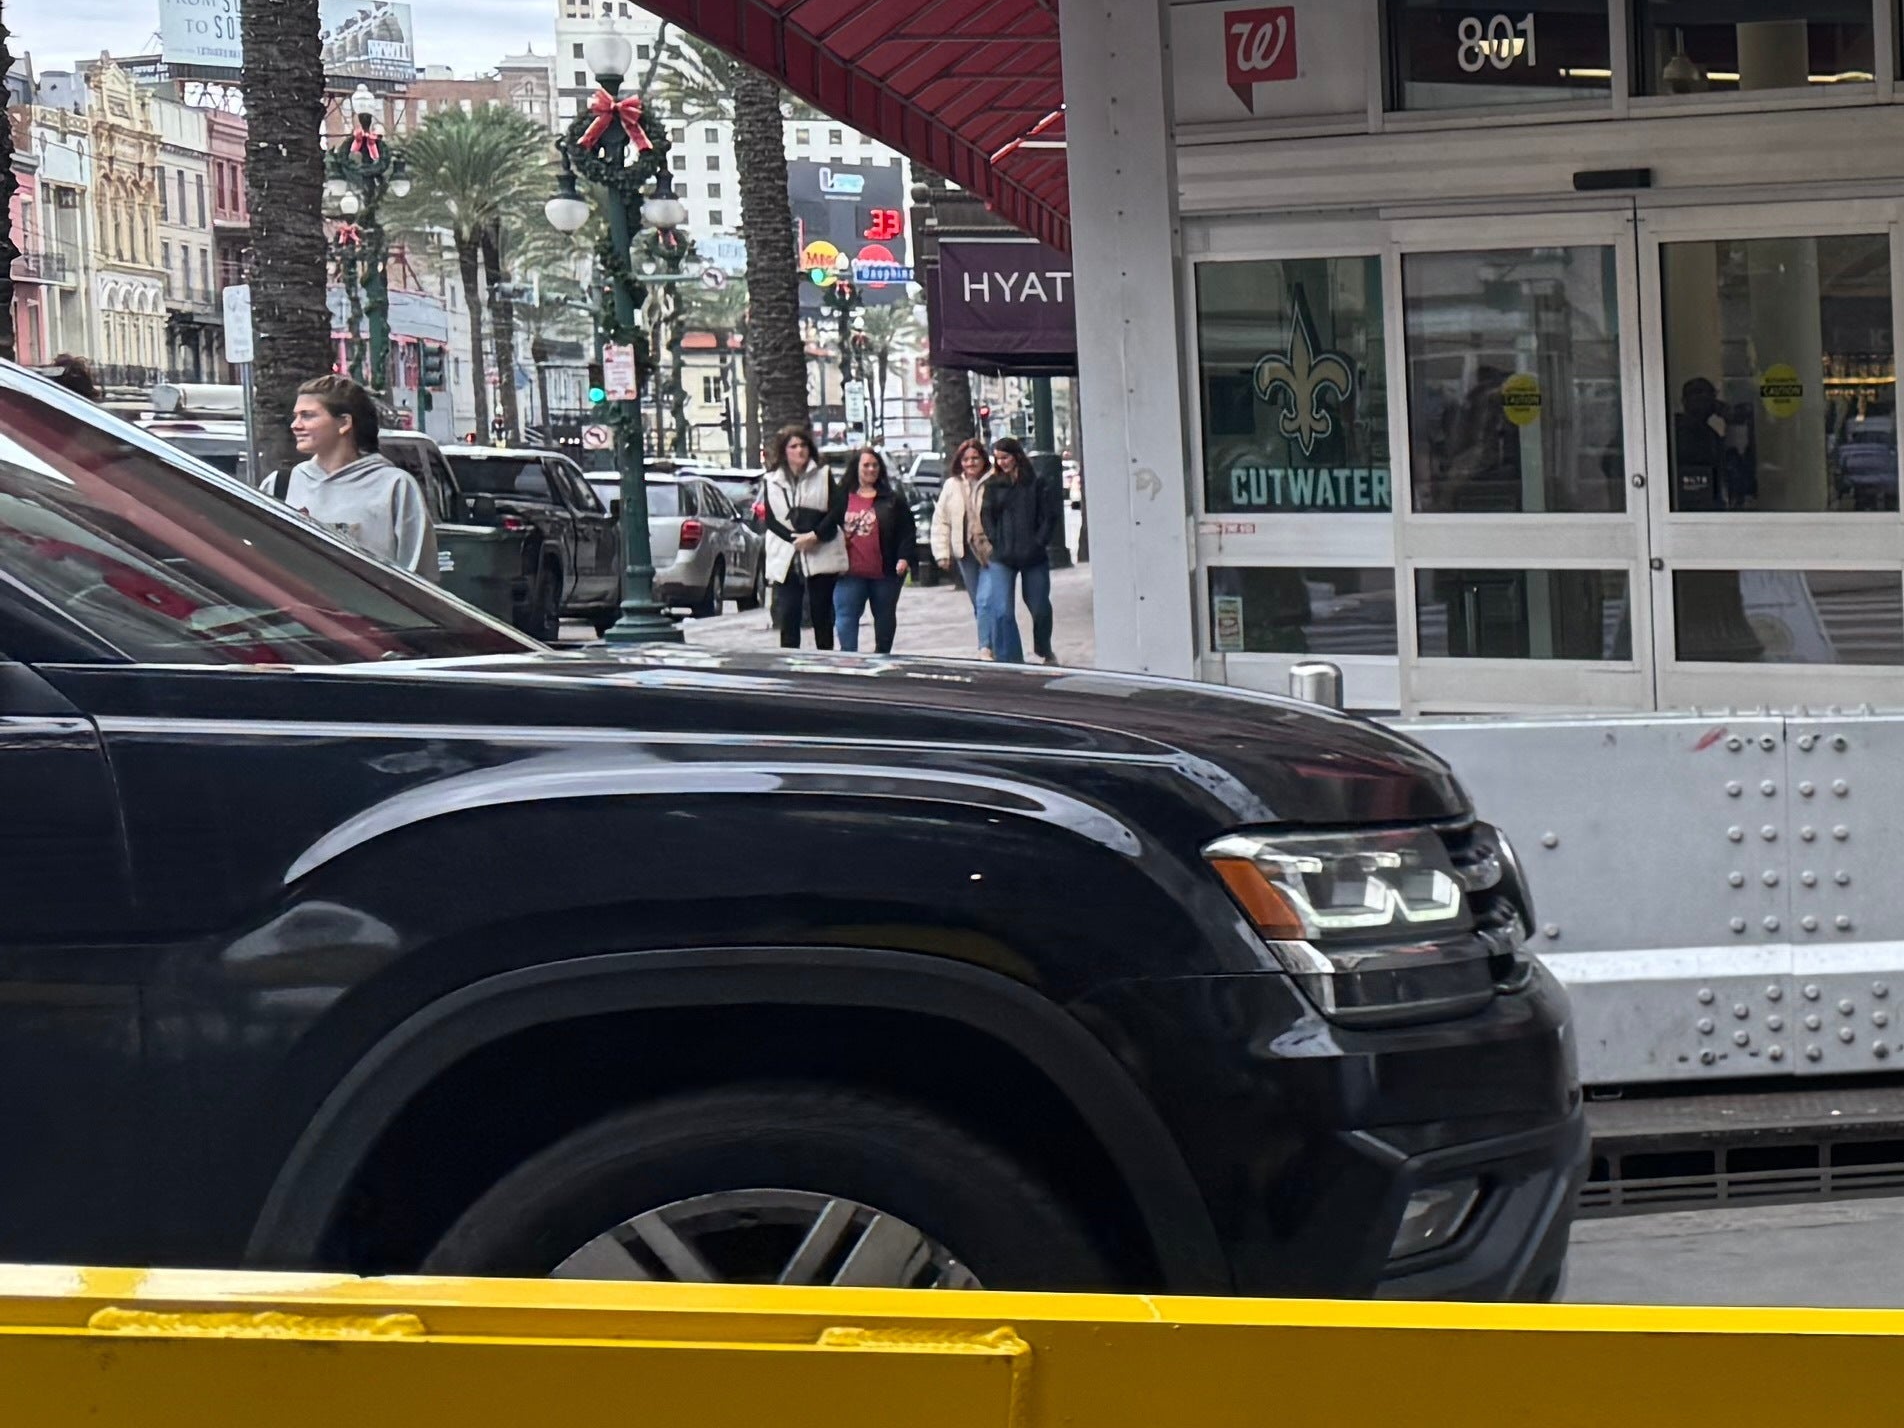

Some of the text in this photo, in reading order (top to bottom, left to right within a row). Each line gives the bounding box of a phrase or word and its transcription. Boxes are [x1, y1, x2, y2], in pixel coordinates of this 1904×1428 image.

[184, 18, 208, 34] TO
[1230, 15, 1287, 72] W
[1458, 12, 1537, 72] 801
[1231, 468, 1393, 506] CUTWATER
